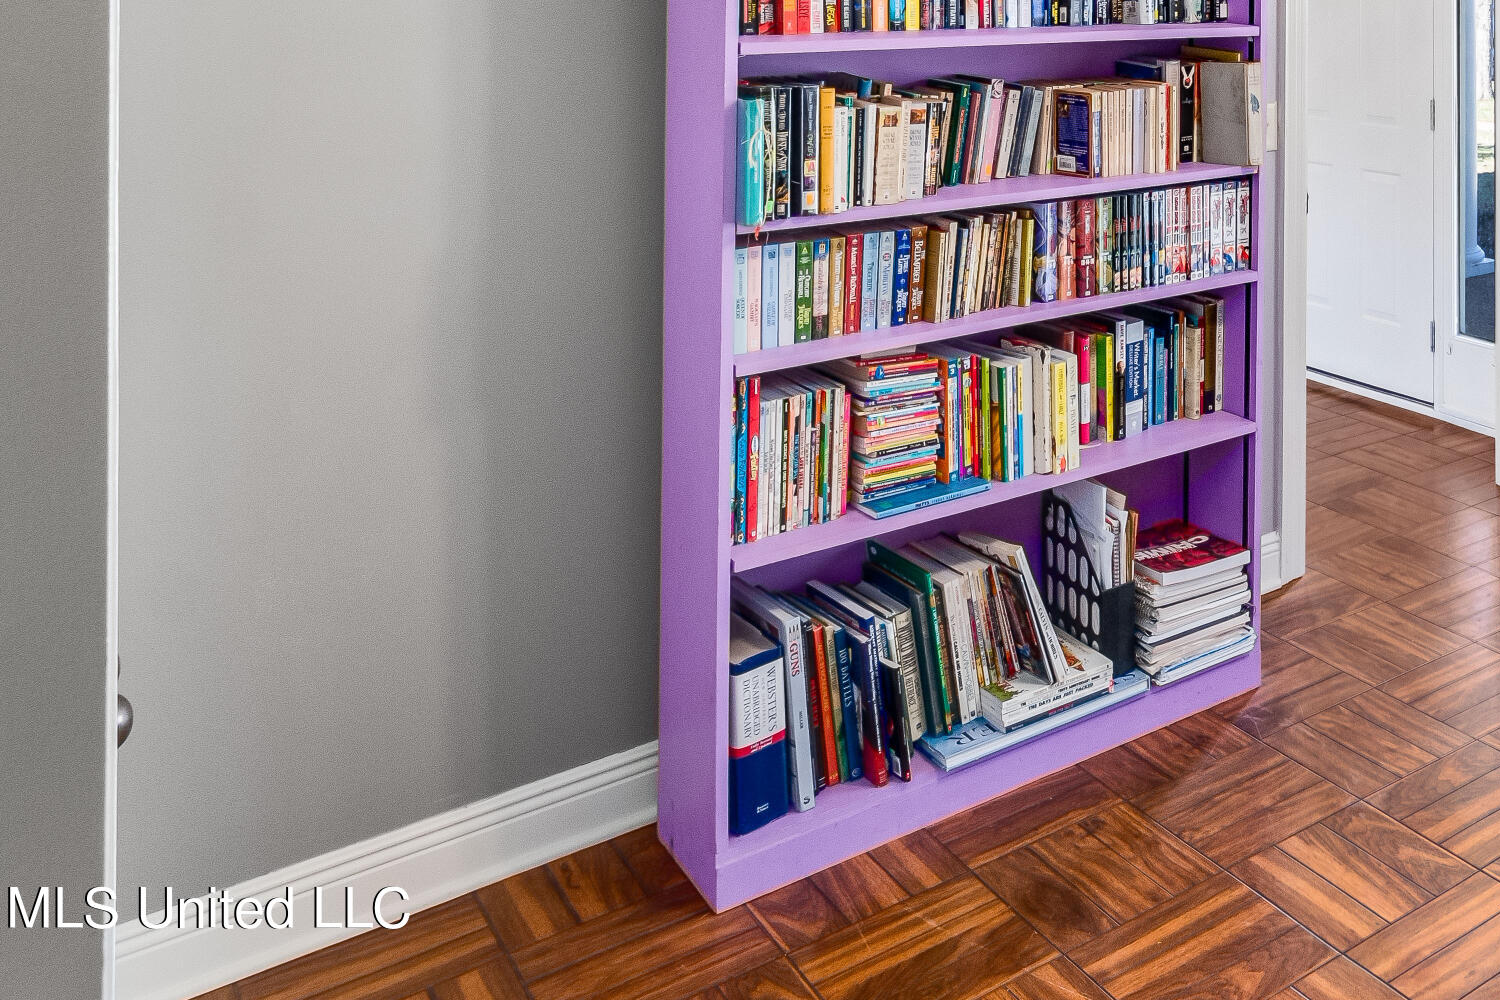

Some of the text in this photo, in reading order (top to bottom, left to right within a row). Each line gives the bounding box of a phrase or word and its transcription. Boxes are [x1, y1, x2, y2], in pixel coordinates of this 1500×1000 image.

[764, 4, 774, 23] PRIVATE
[826, 5, 836, 26] VEGAS
[1133, 341, 1141, 370] Writer's
[900, 624, 914, 651] WORLD
[1038, 607, 1058, 659] CALVIN HOBBES
[789, 642, 800, 677] GUNS
[839, 648, 848, 664] 100
[901, 651, 916, 668] WAR
[841, 666, 853, 708] BATTLES
[961, 644, 974, 702] CALVIN HOBBES
[752, 675, 761, 736] UNABRIDGED
[766, 665, 777, 732] WEBSTER'S
[906, 677, 917, 707] REFERENCE
[1038, 699, 1052, 707] DAYS
[1062, 690, 1074, 698] JUST
[1075, 682, 1094, 694] PACKED
[742, 679, 752, 739] DICTIONARY
